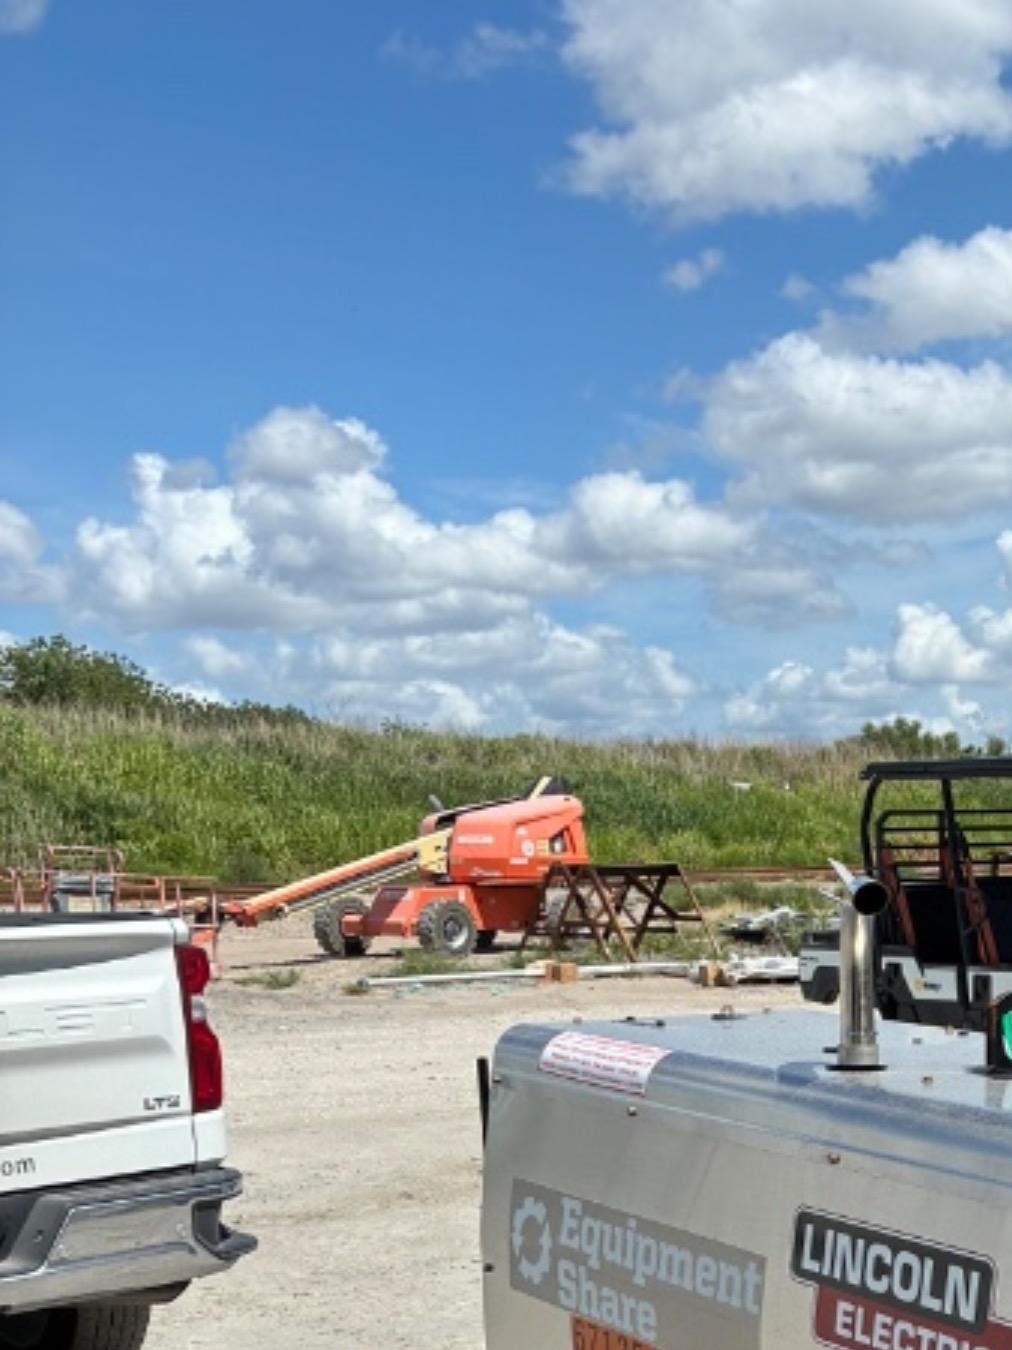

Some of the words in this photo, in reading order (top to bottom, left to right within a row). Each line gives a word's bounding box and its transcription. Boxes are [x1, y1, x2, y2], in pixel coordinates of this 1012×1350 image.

[557, 1258, 658, 1342] Share
[559, 1195, 763, 1316] Equipment
[801, 1223, 981, 1325] LINCOLN
